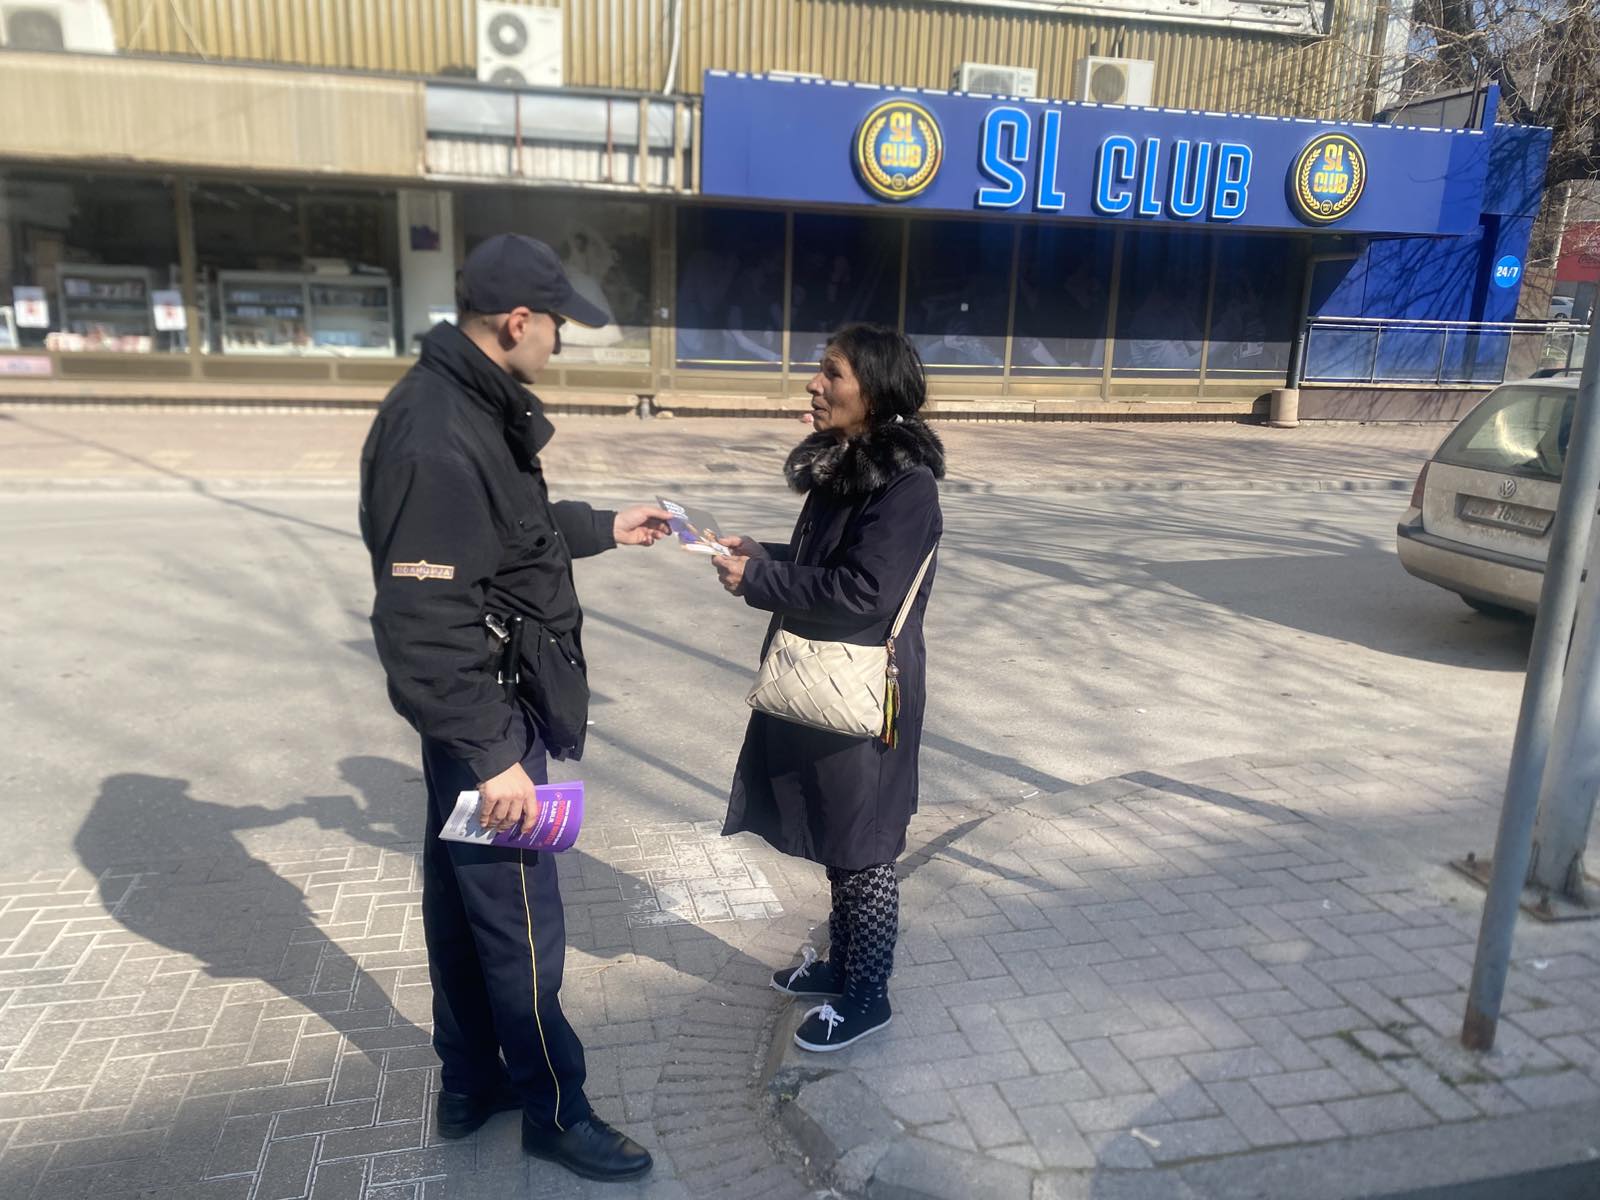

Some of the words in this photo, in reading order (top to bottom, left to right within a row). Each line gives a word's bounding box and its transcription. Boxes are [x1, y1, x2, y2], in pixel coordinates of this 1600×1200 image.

[889, 111, 914, 142] SL
[880, 142, 922, 168] CLUB
[978, 106, 1065, 209] SL
[1096, 135, 1253, 219] CLUB
[1322, 143, 1344, 171] SL
[1313, 171, 1349, 194] CLUB
[1496, 265, 1519, 278] 24/7
